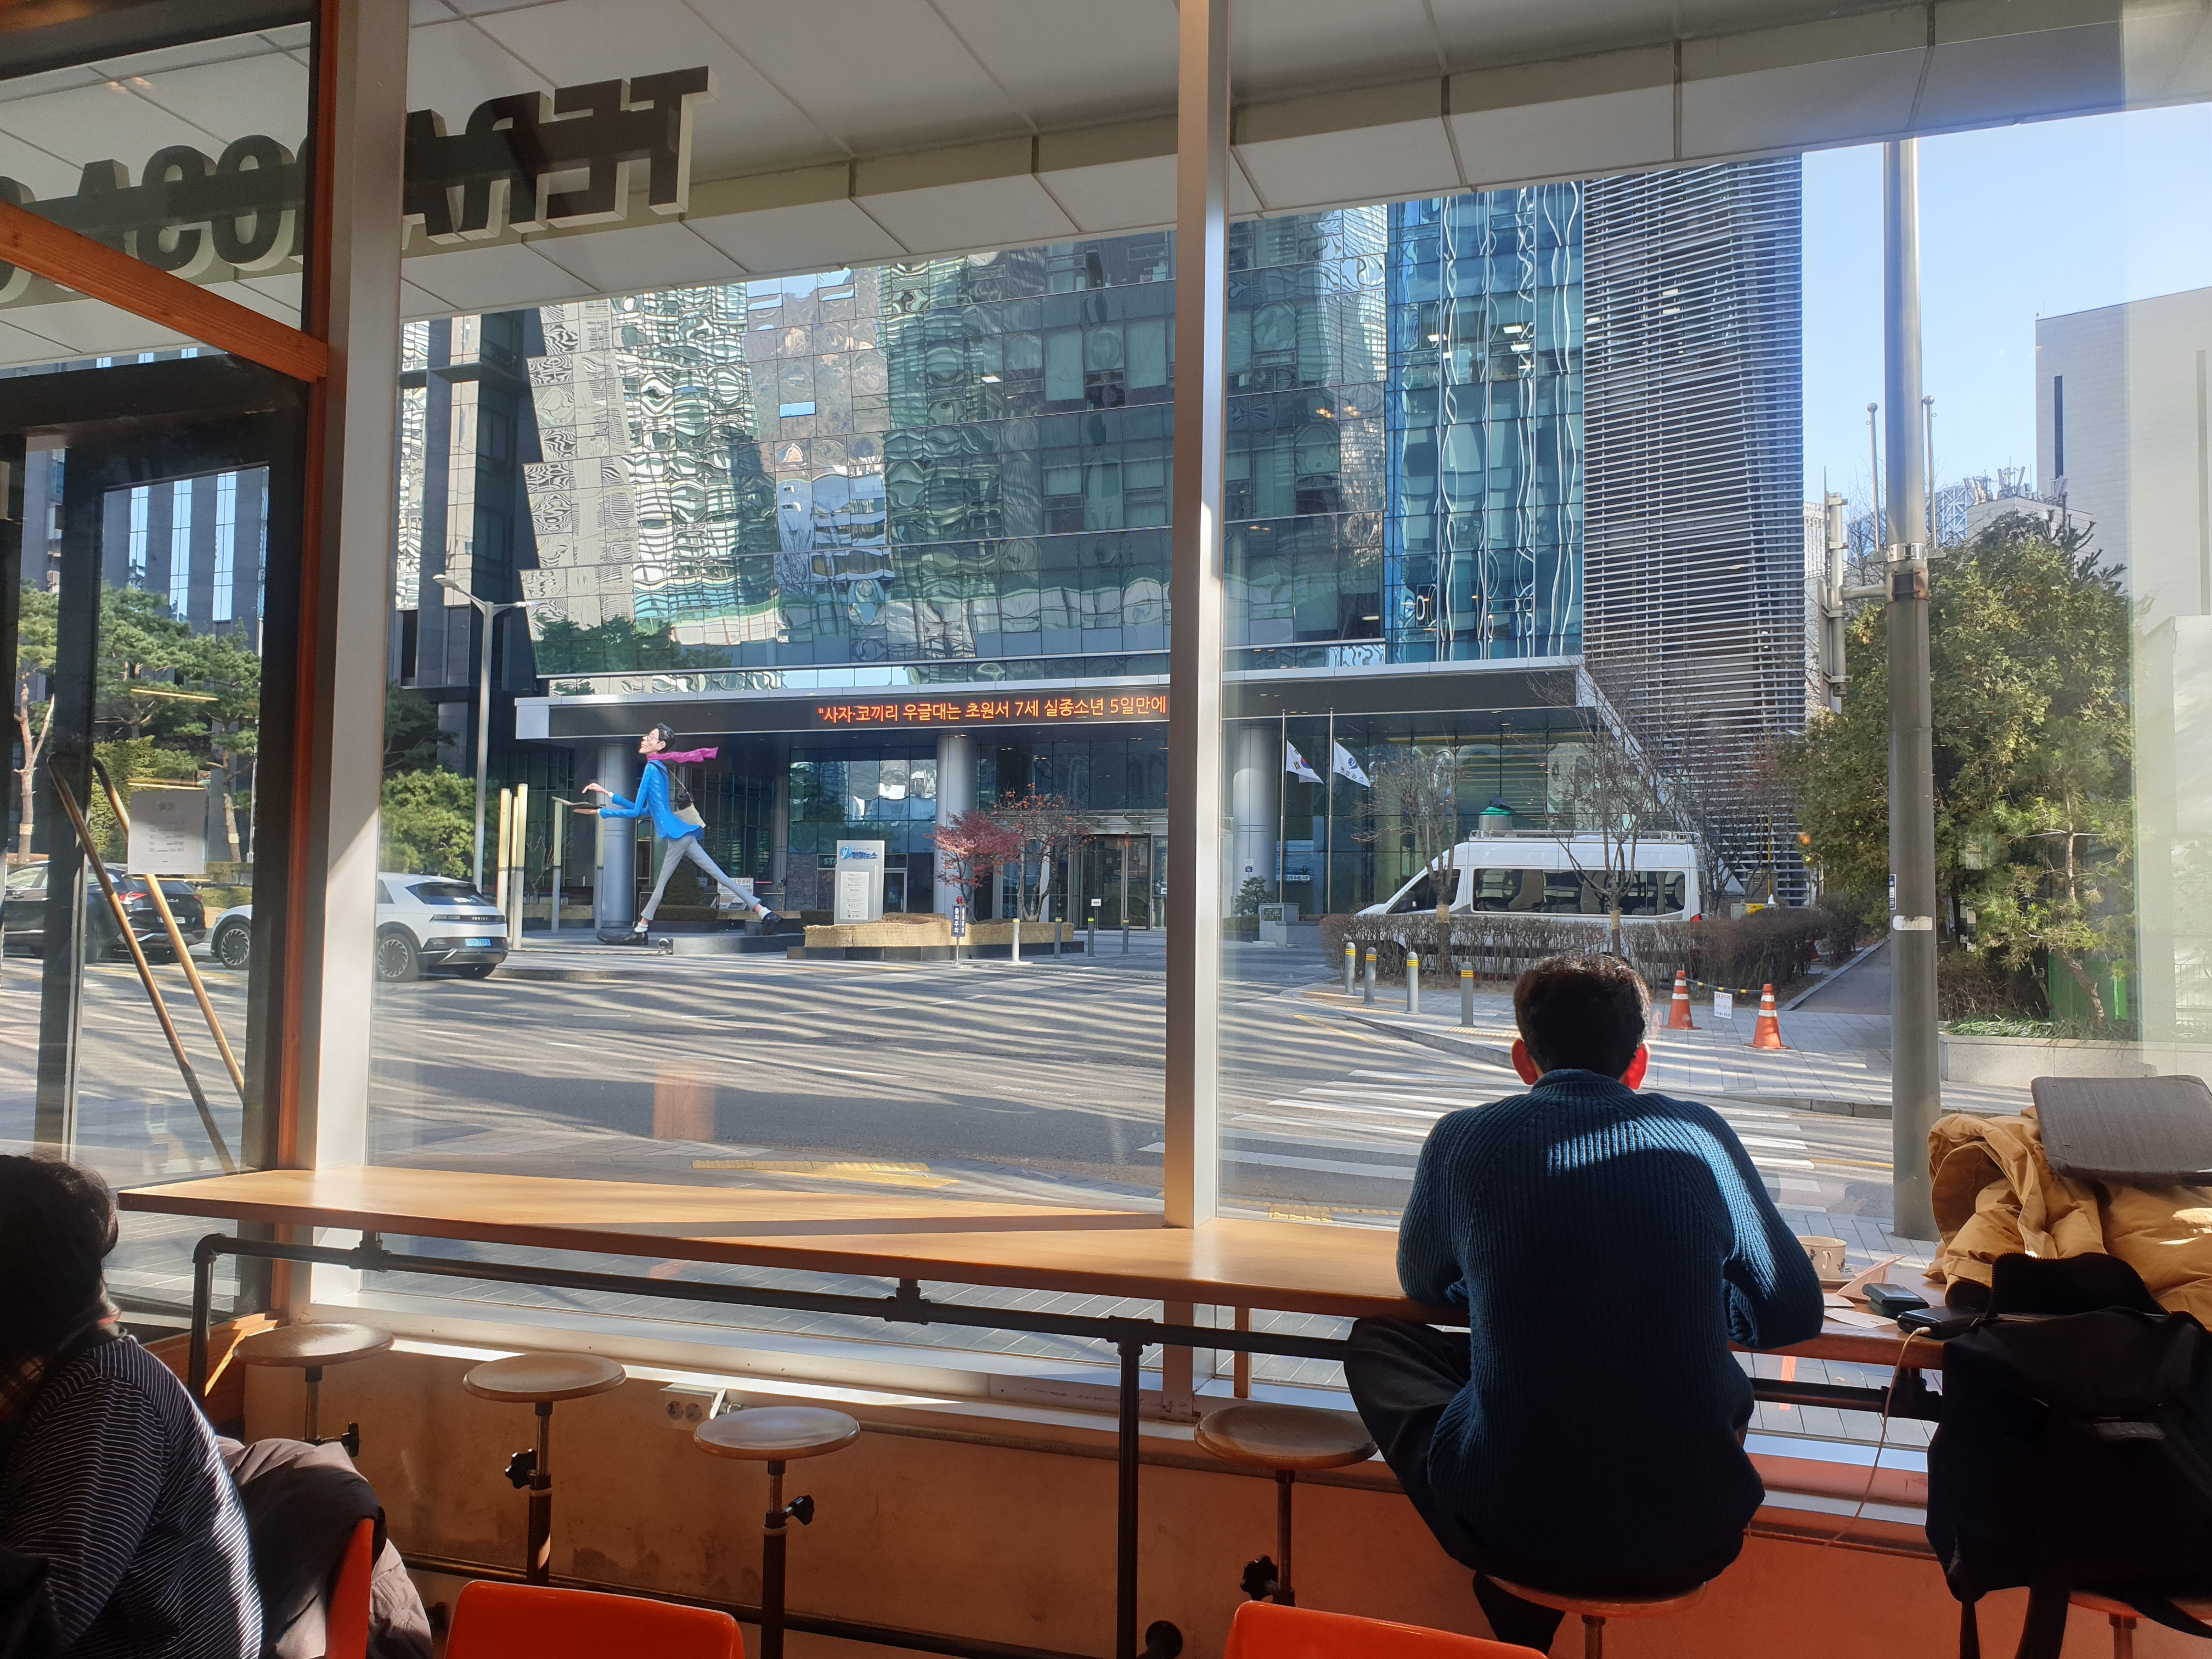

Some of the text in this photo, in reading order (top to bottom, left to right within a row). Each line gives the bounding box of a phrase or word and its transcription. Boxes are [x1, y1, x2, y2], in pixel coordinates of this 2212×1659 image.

[903, 703, 961, 721] 우글대는
[966, 702, 1008, 718] 초원서
[1015, 700, 1038, 717] 7세
[1045, 698, 1104, 716] 실종소년
[1110, 696, 1166, 715] 5일만에
[1340, 767, 1364, 782] 연합뉴스
